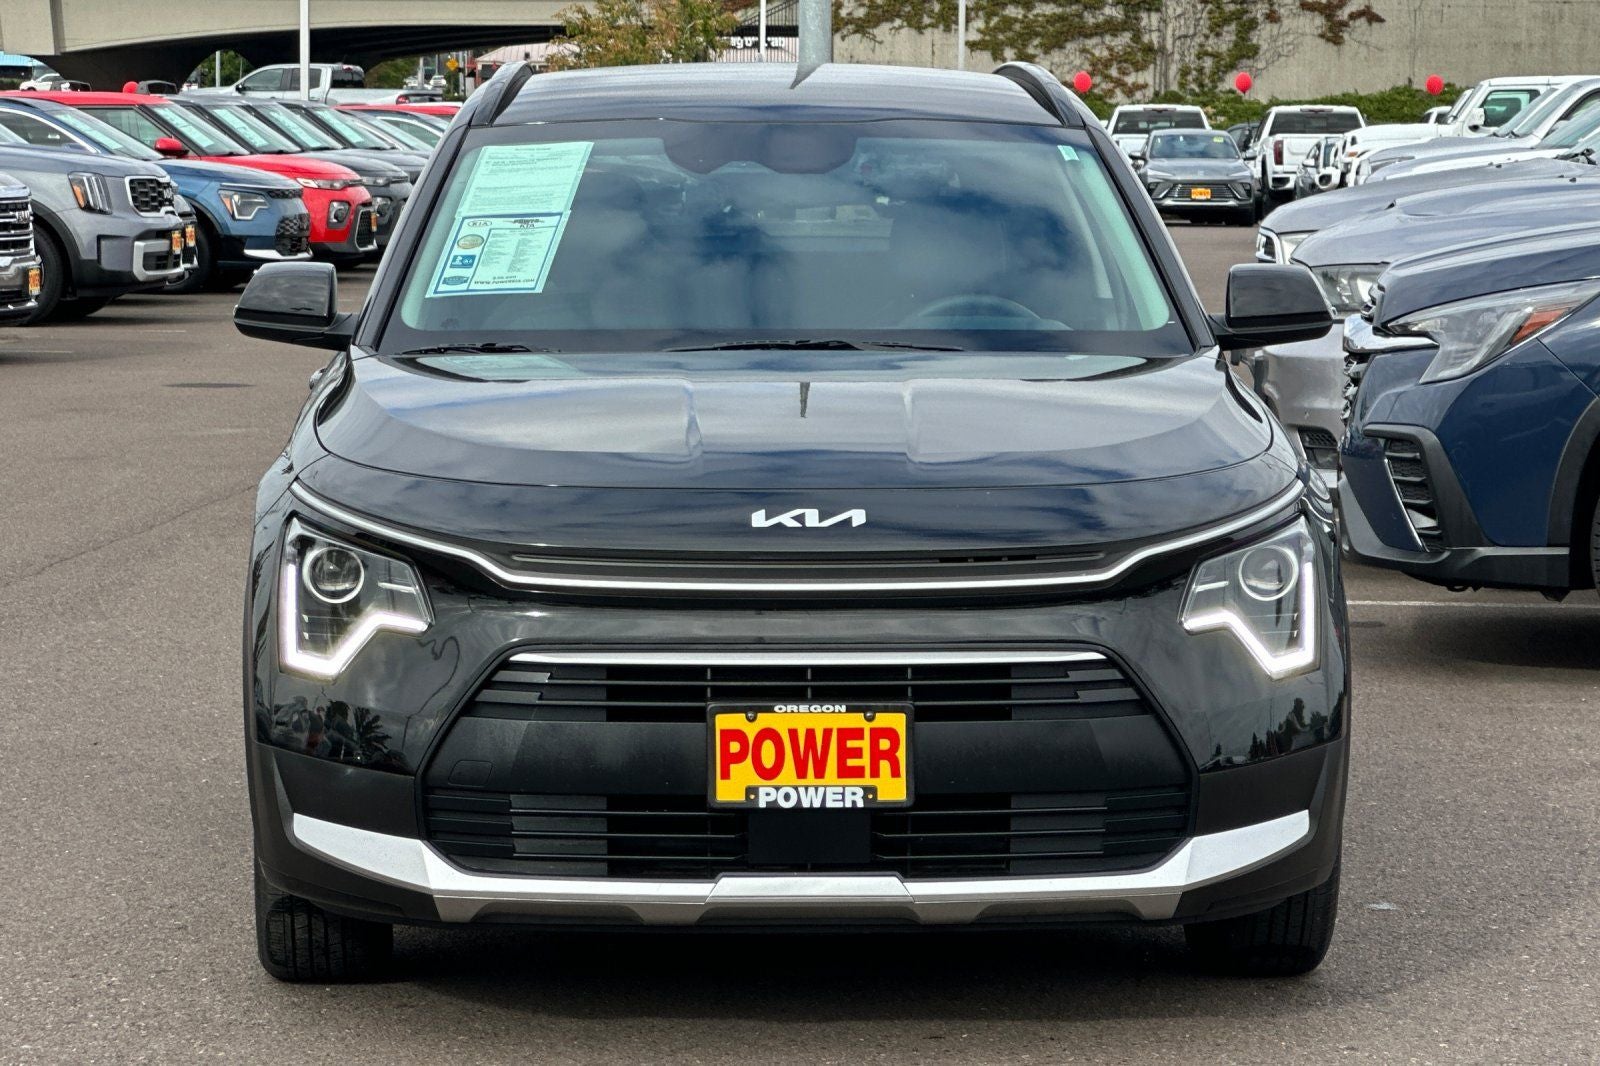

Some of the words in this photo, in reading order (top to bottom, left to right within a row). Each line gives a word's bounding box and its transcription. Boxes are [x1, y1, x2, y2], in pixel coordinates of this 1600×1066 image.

[751, 508, 866, 528] KIA
[773, 704, 847, 713] OREGON
[719, 727, 902, 781] POWER
[758, 786, 864, 809] POWER
